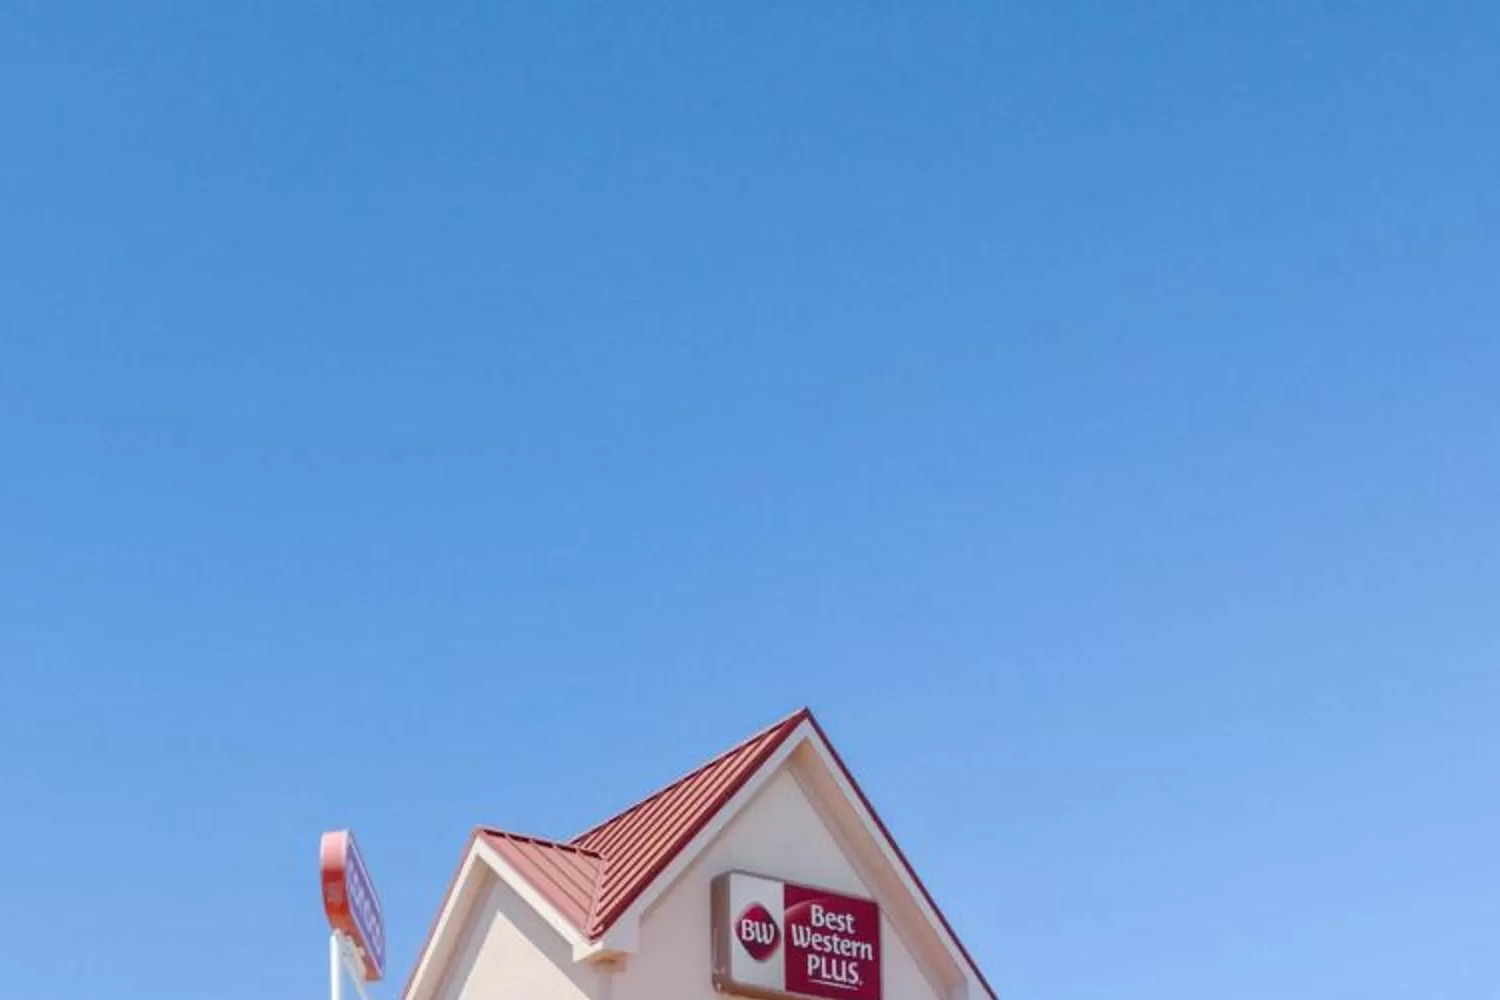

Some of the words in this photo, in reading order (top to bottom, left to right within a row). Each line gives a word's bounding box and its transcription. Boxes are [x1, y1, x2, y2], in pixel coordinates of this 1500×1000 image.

[741, 919, 775, 945] BW
[811, 903, 856, 934] Best
[791, 923, 873, 960] Western
